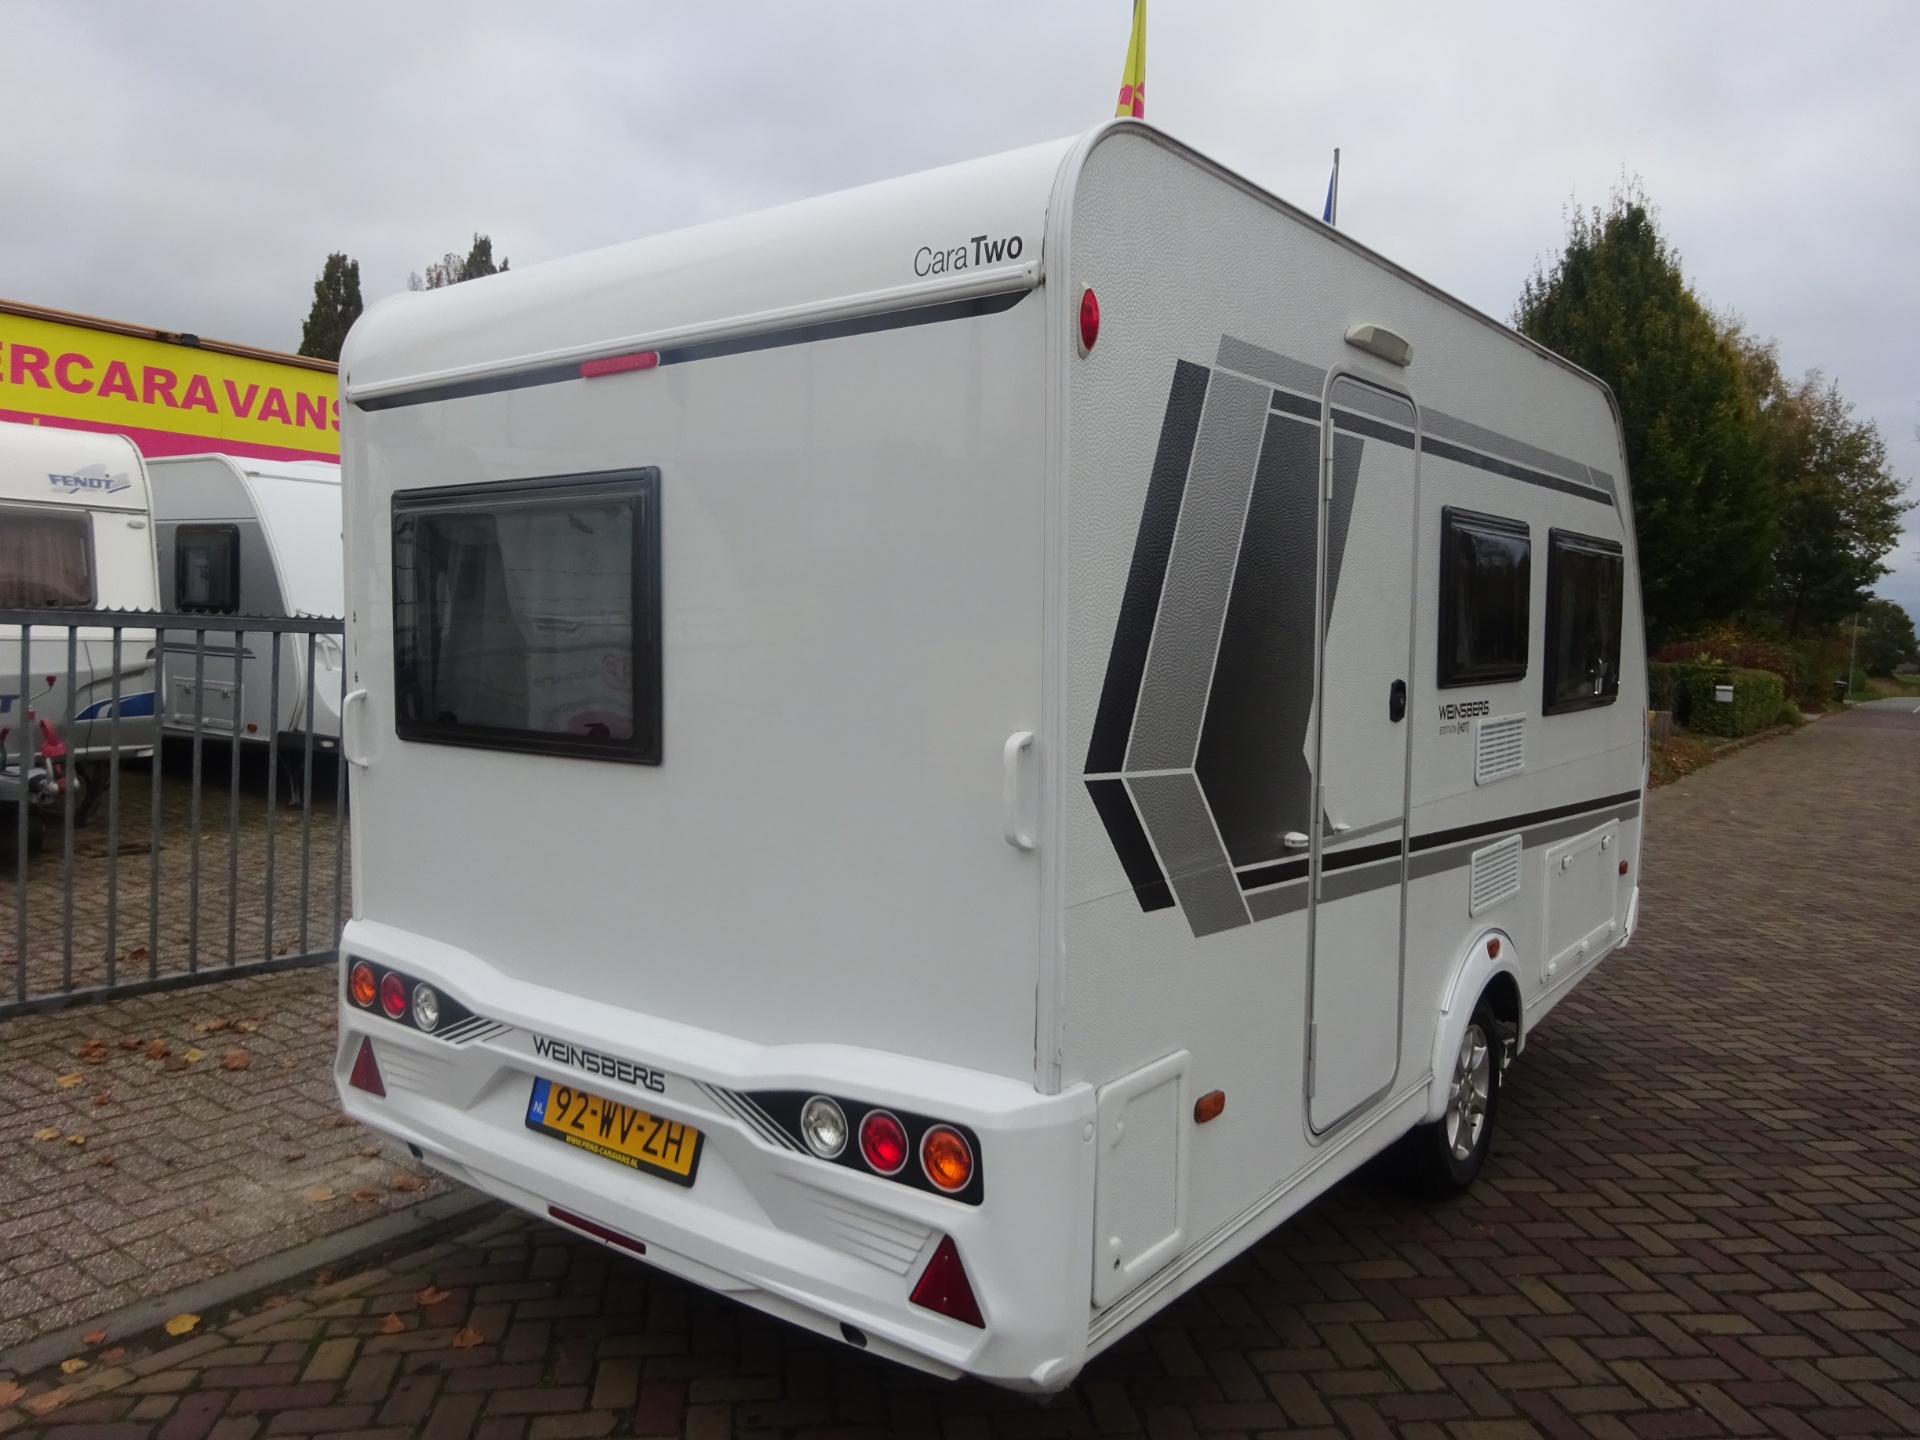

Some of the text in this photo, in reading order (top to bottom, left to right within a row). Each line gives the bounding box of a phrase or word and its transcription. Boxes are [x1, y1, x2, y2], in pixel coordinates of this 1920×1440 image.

[914, 235, 1023, 277] CaraTwo
[0, 341, 340, 433] RCARAVAN
[48, 473, 115, 490] FENDT
[1439, 700, 1489, 720] WEINSBERG
[533, 1035, 665, 1093] WEINSBERG
[533, 1086, 687, 1164] NL 92-WV-ZH
